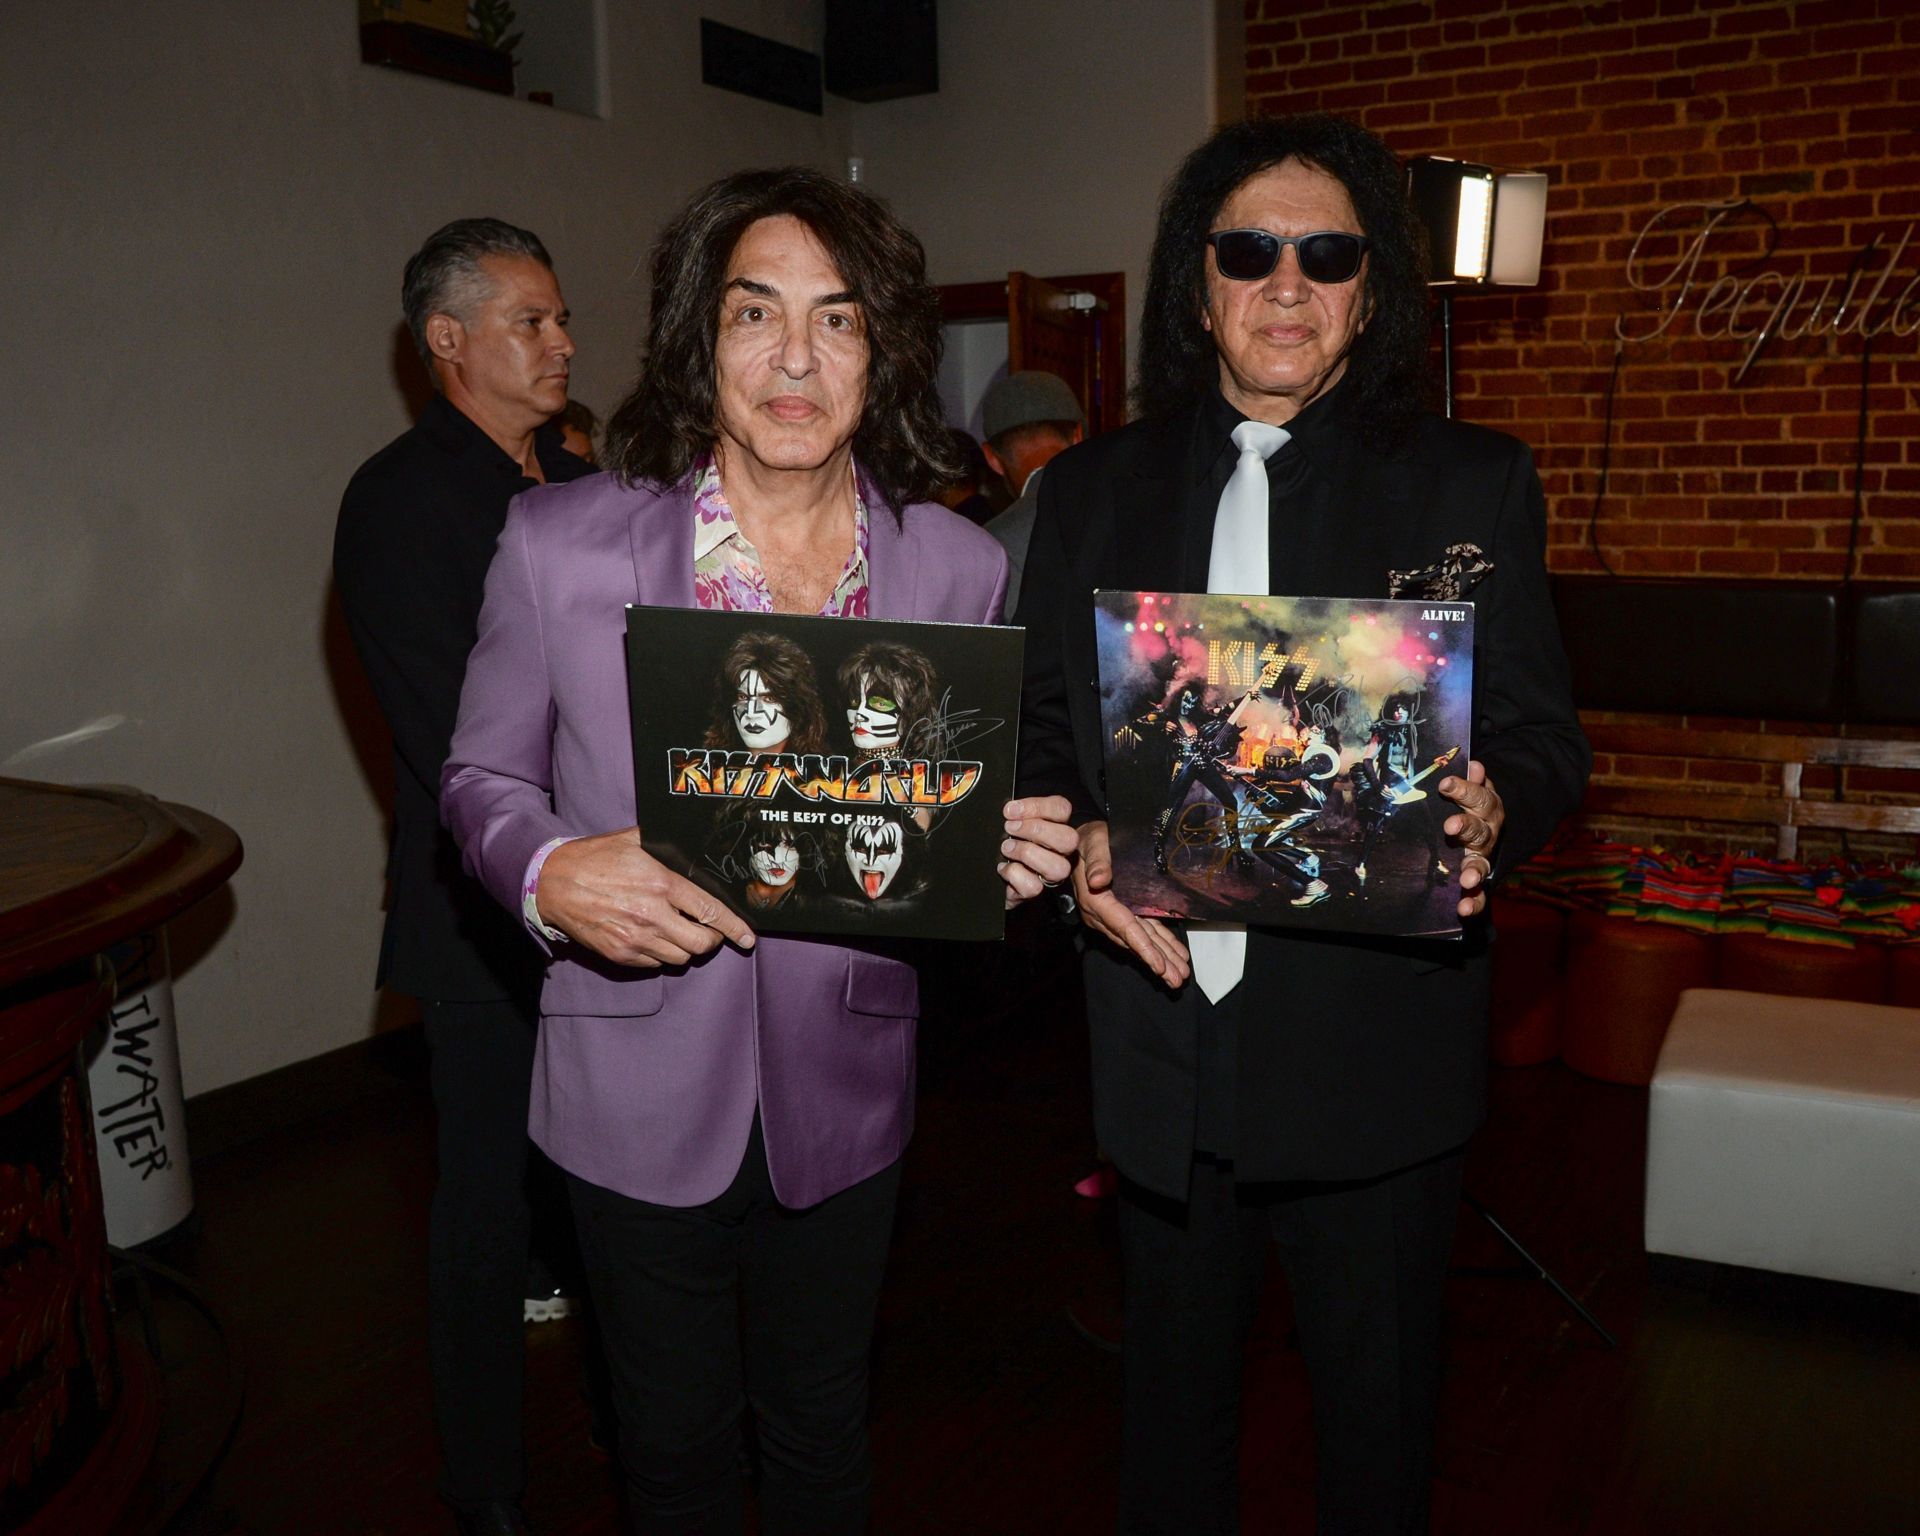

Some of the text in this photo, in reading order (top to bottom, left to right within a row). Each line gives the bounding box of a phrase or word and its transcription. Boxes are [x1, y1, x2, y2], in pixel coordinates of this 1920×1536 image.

[1421, 609, 1466, 622] ALIVE!
[1207, 639, 1321, 692] KISS
[760, 809, 886, 827] THE BEST OF KISS
